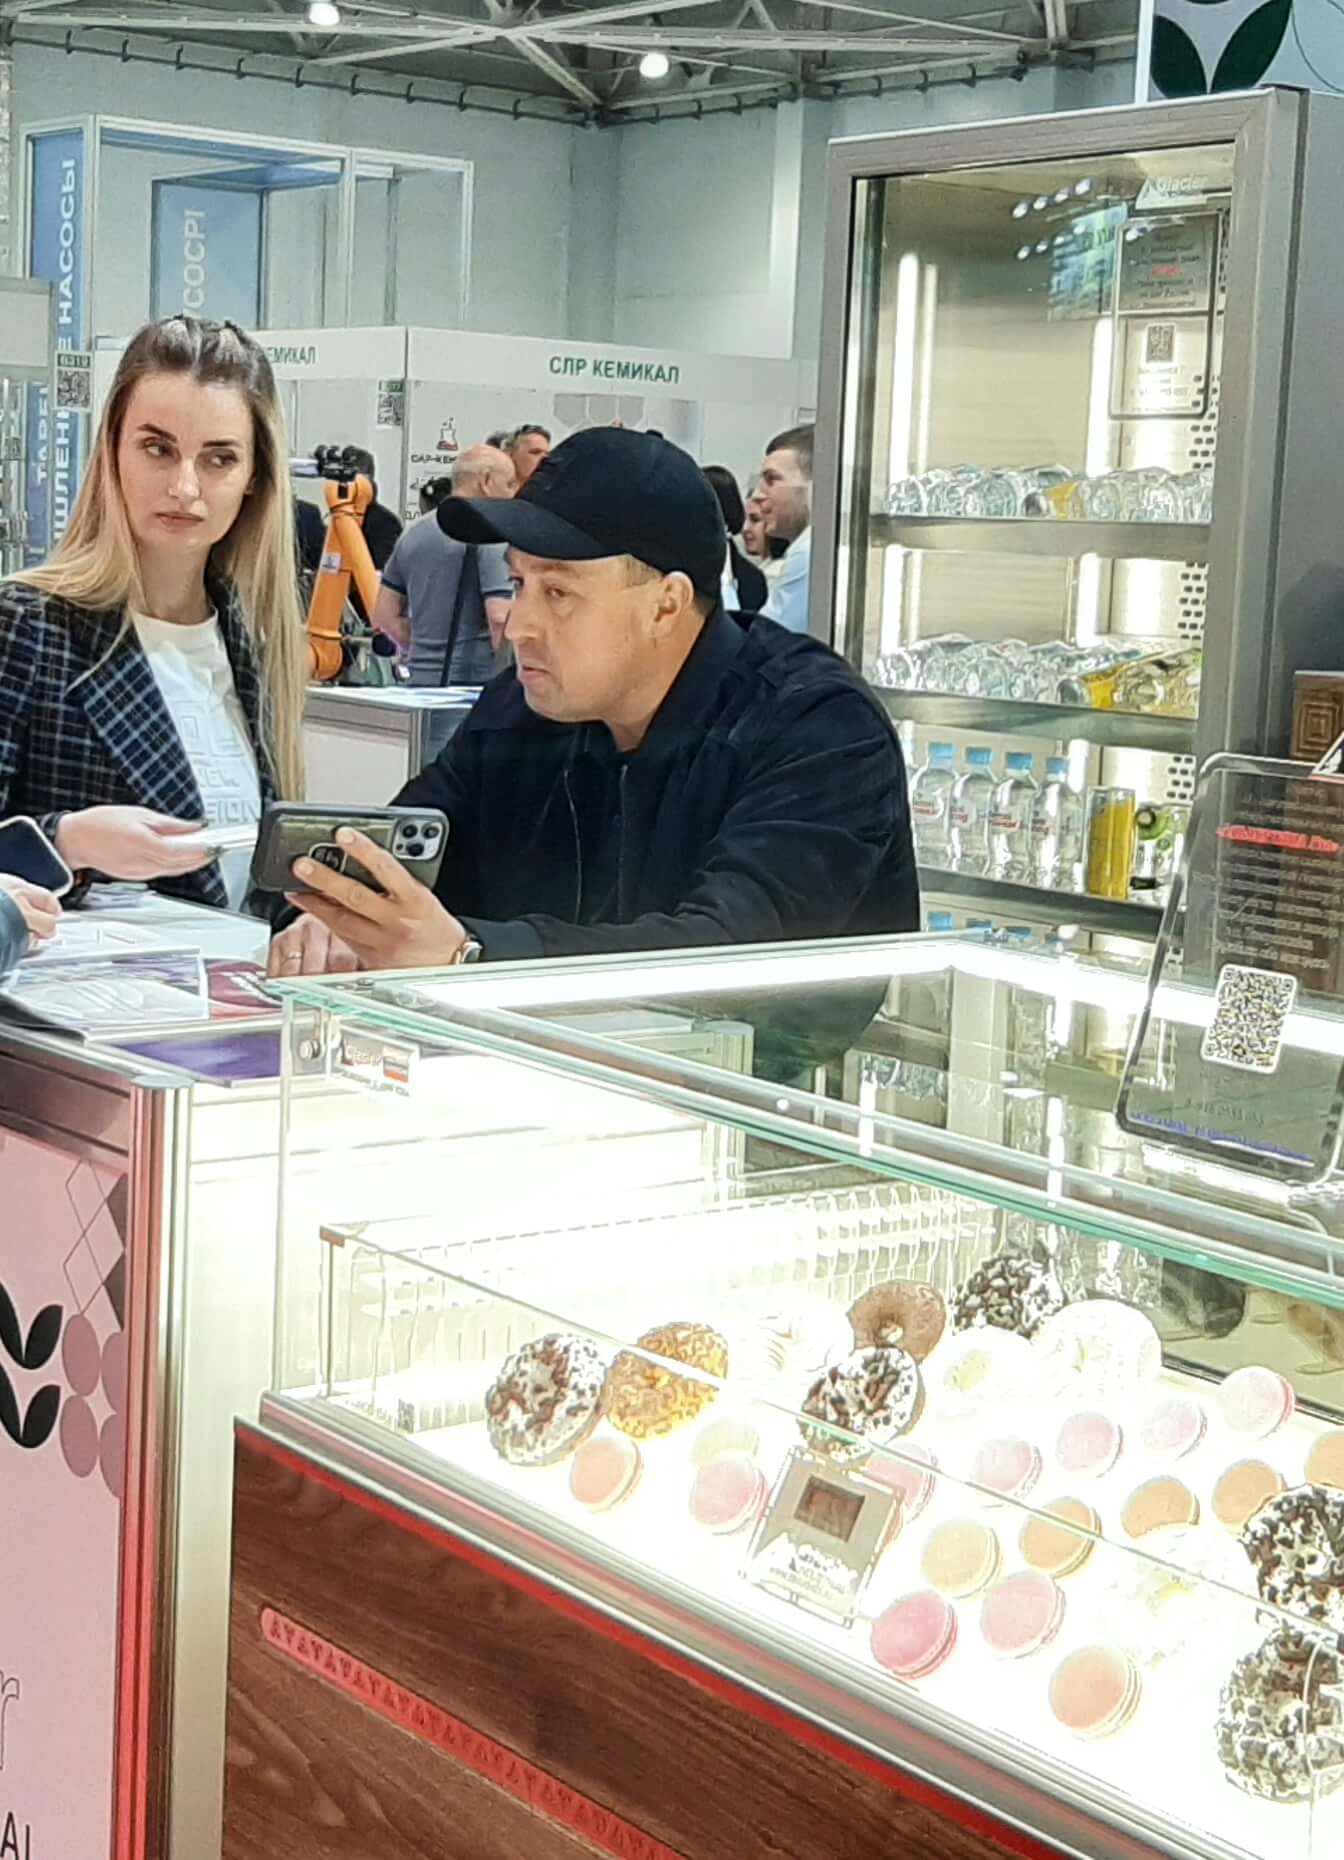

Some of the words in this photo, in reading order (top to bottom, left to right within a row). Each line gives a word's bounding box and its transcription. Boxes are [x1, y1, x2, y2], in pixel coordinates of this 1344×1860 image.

[59, 159, 75, 324] НАСОСЫ
[266, 346, 316, 364] ЕМИКАЛ
[549, 356, 587, 377] СЛР
[593, 359, 680, 385] КЕМИКАЛ
